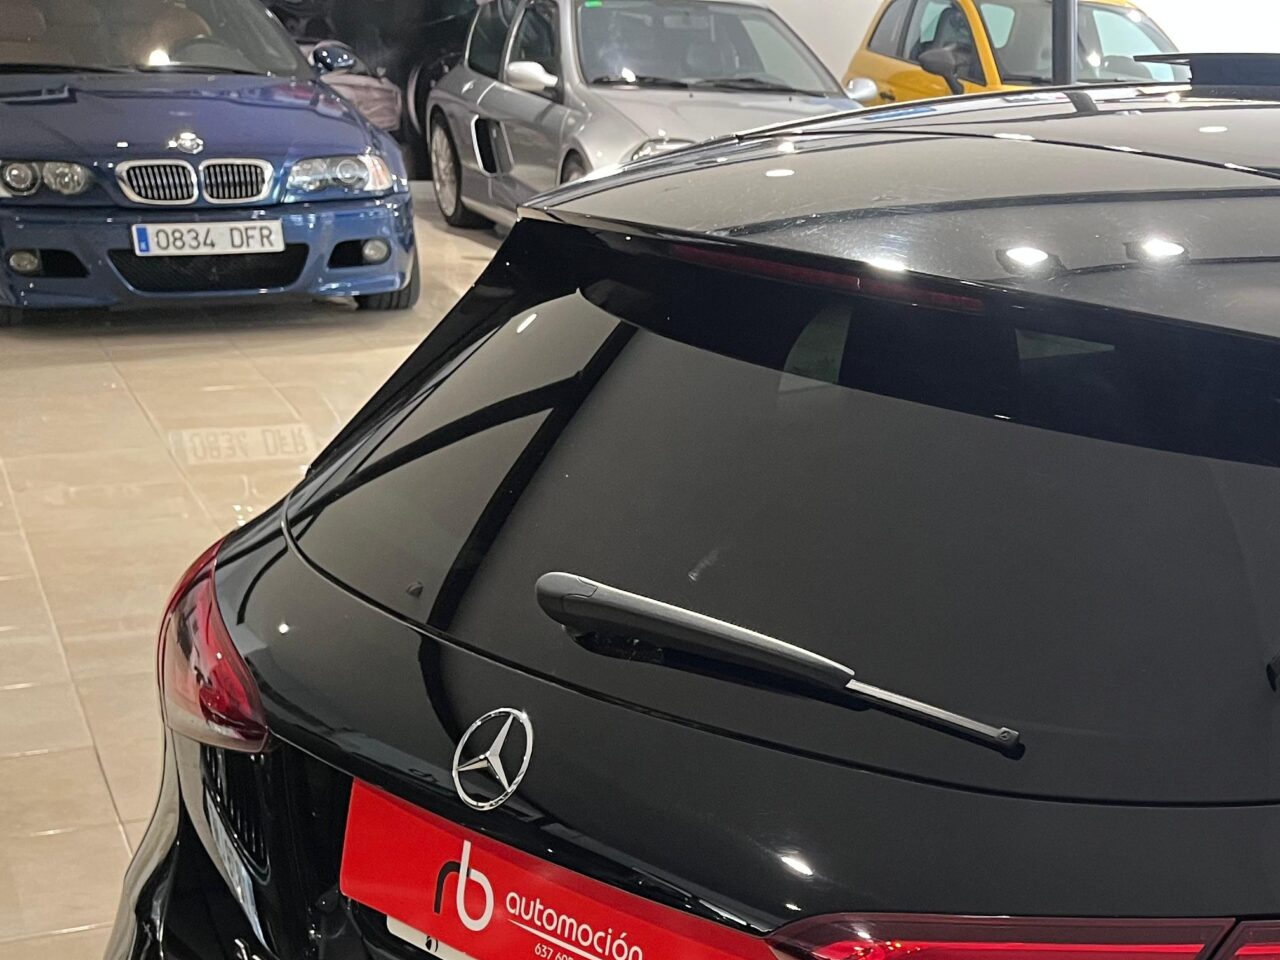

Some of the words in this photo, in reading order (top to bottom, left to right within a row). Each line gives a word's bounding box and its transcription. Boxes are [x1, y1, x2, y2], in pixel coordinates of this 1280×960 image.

[155, 228, 216, 250] 0834
[229, 226, 274, 249] DFR
[534, 942, 554, 960] 637
